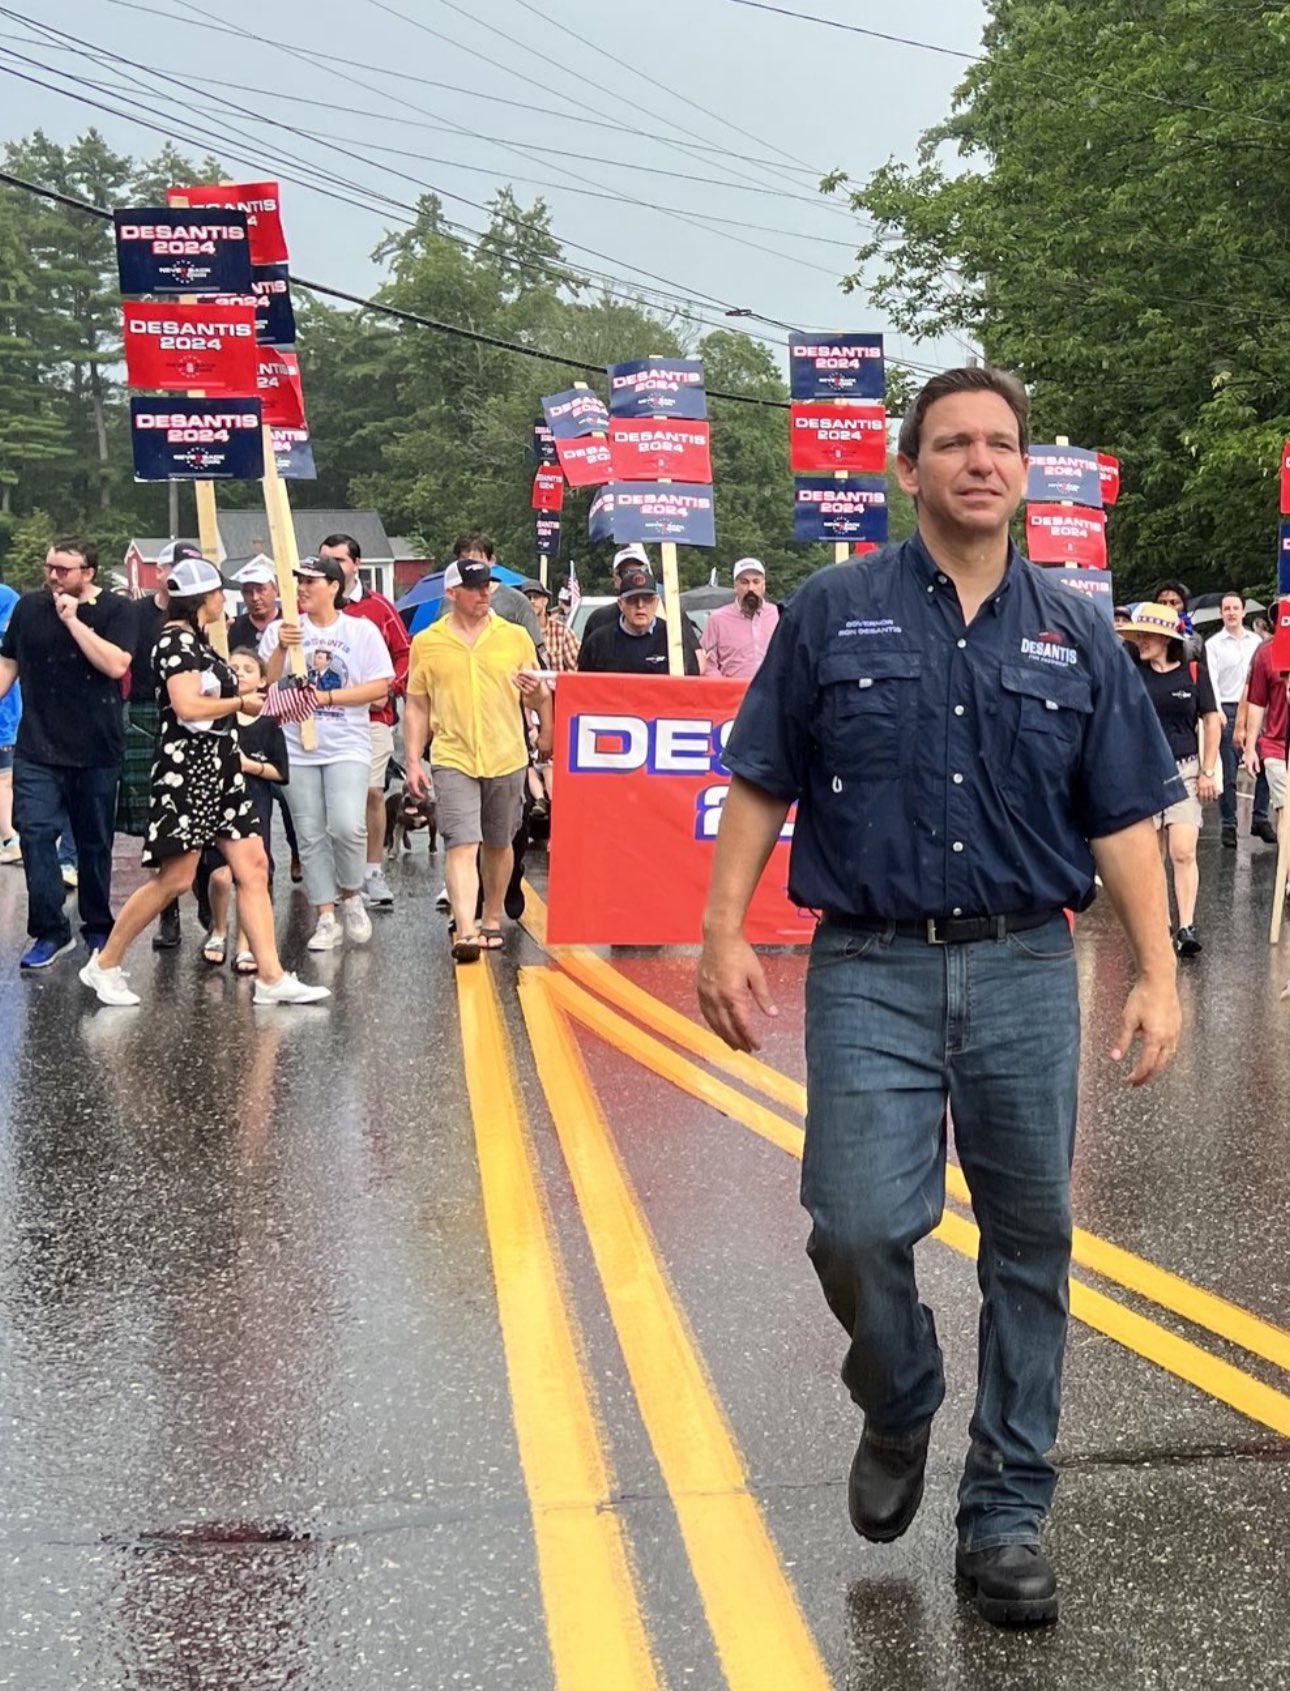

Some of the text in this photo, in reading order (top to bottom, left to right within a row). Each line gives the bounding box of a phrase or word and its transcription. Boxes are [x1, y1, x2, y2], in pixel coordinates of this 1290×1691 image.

[120, 226, 245, 241] DESANTIS
[153, 241, 216, 255] 2024
[130, 320, 252, 336] DESANTIS
[159, 338, 221, 351] 2024
[793, 345, 881, 358] DESANTIS
[815, 358, 860, 369] 2024
[613, 369, 701, 389] DESANTIS
[635, 380, 679, 392] 2024
[136, 414, 259, 430] DESANTIS
[795, 417, 884, 431] DESANTIS
[168, 429, 230, 443] 2024
[615, 432, 706, 446] DESANTIS
[817, 430, 862, 441] 2024
[638, 442, 684, 453] 2024
[617, 494, 710, 509] DESANTIS
[798, 490, 886, 504] DESANTIS
[642, 505, 688, 518] 2024
[820, 503, 865, 514] 2024
[1031, 515, 1101, 533] DESANTIS
[1021, 637, 1078, 665] DESANTIS
[568, 713, 736, 778] DE
